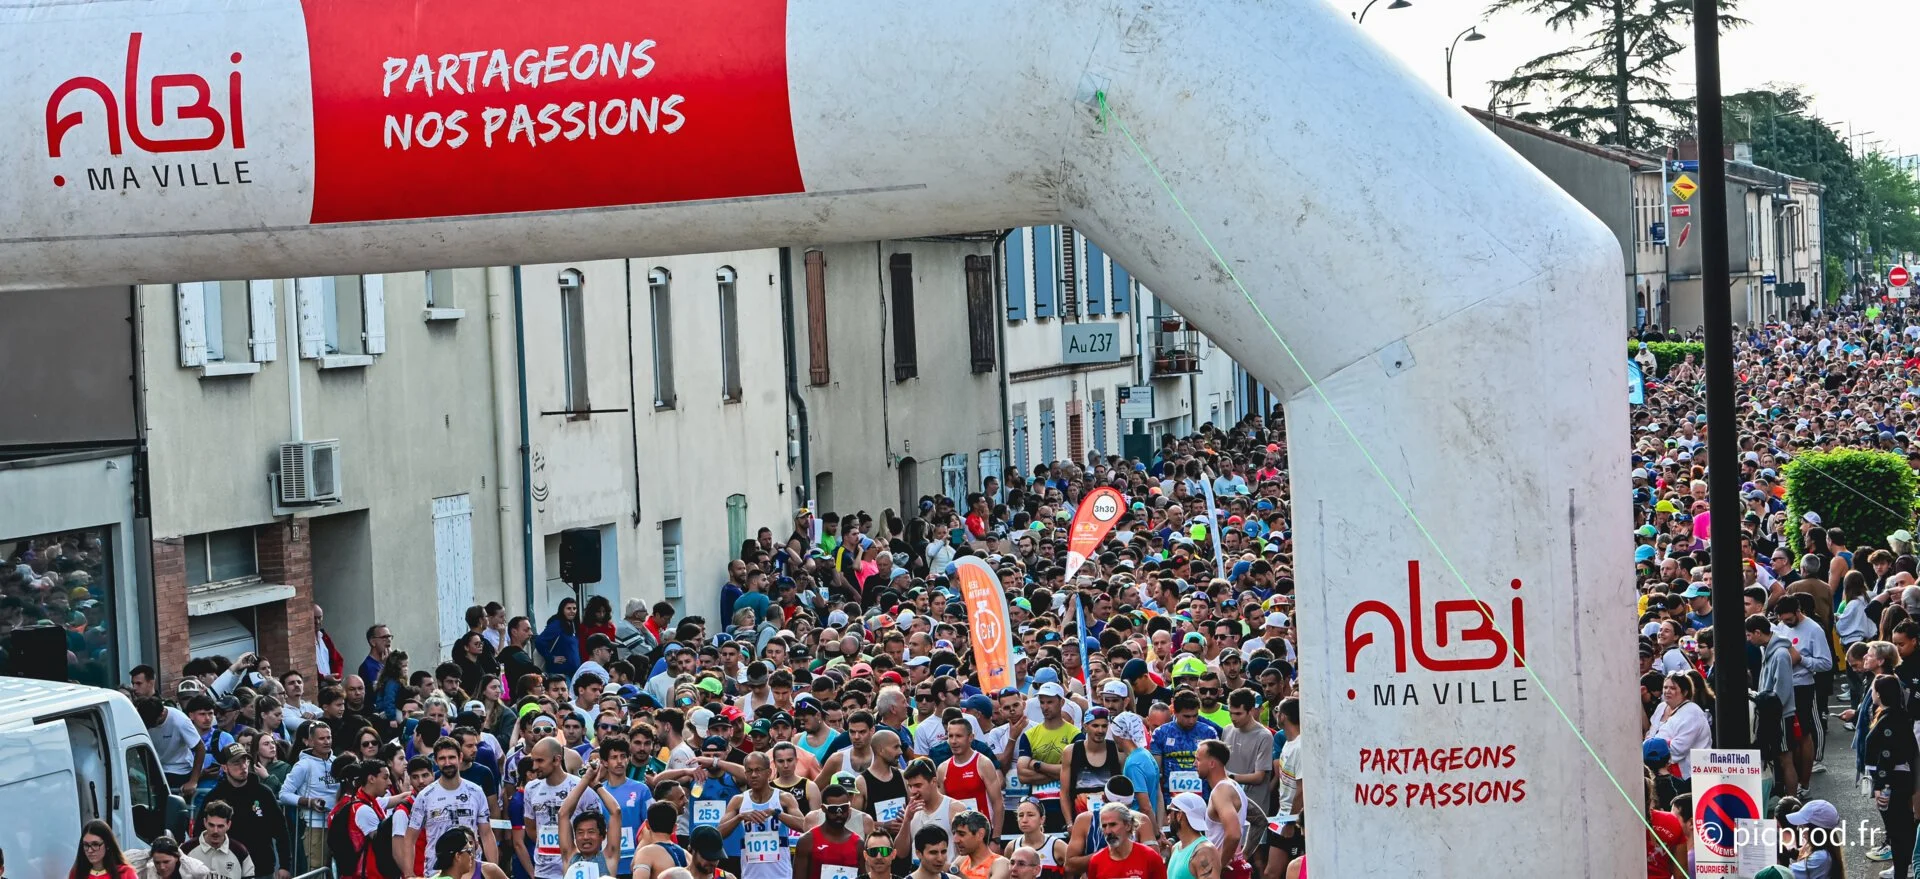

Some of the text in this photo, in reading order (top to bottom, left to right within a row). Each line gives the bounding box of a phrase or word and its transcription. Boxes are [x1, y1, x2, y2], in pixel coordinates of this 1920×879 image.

[383, 38, 657, 97] PARTAGEONS
[383, 94, 686, 151] NOS PASSIONS
[87, 160, 253, 191] MA VILLE
[1672, 185, 1687, 201] PRESSE
[1068, 333, 1113, 354] Au 237
[1094, 505, 1115, 513] 3h30
[1373, 678, 1528, 706] MA VILLE
[1360, 744, 1516, 775] PARTAGEONS
[1747, 767, 1760, 775] 15H
[1171, 779, 1201, 790] 1492
[1355, 779, 1526, 809] NOS PASSIONS
[698, 808, 721, 821] 253
[746, 839, 778, 853] 1013
